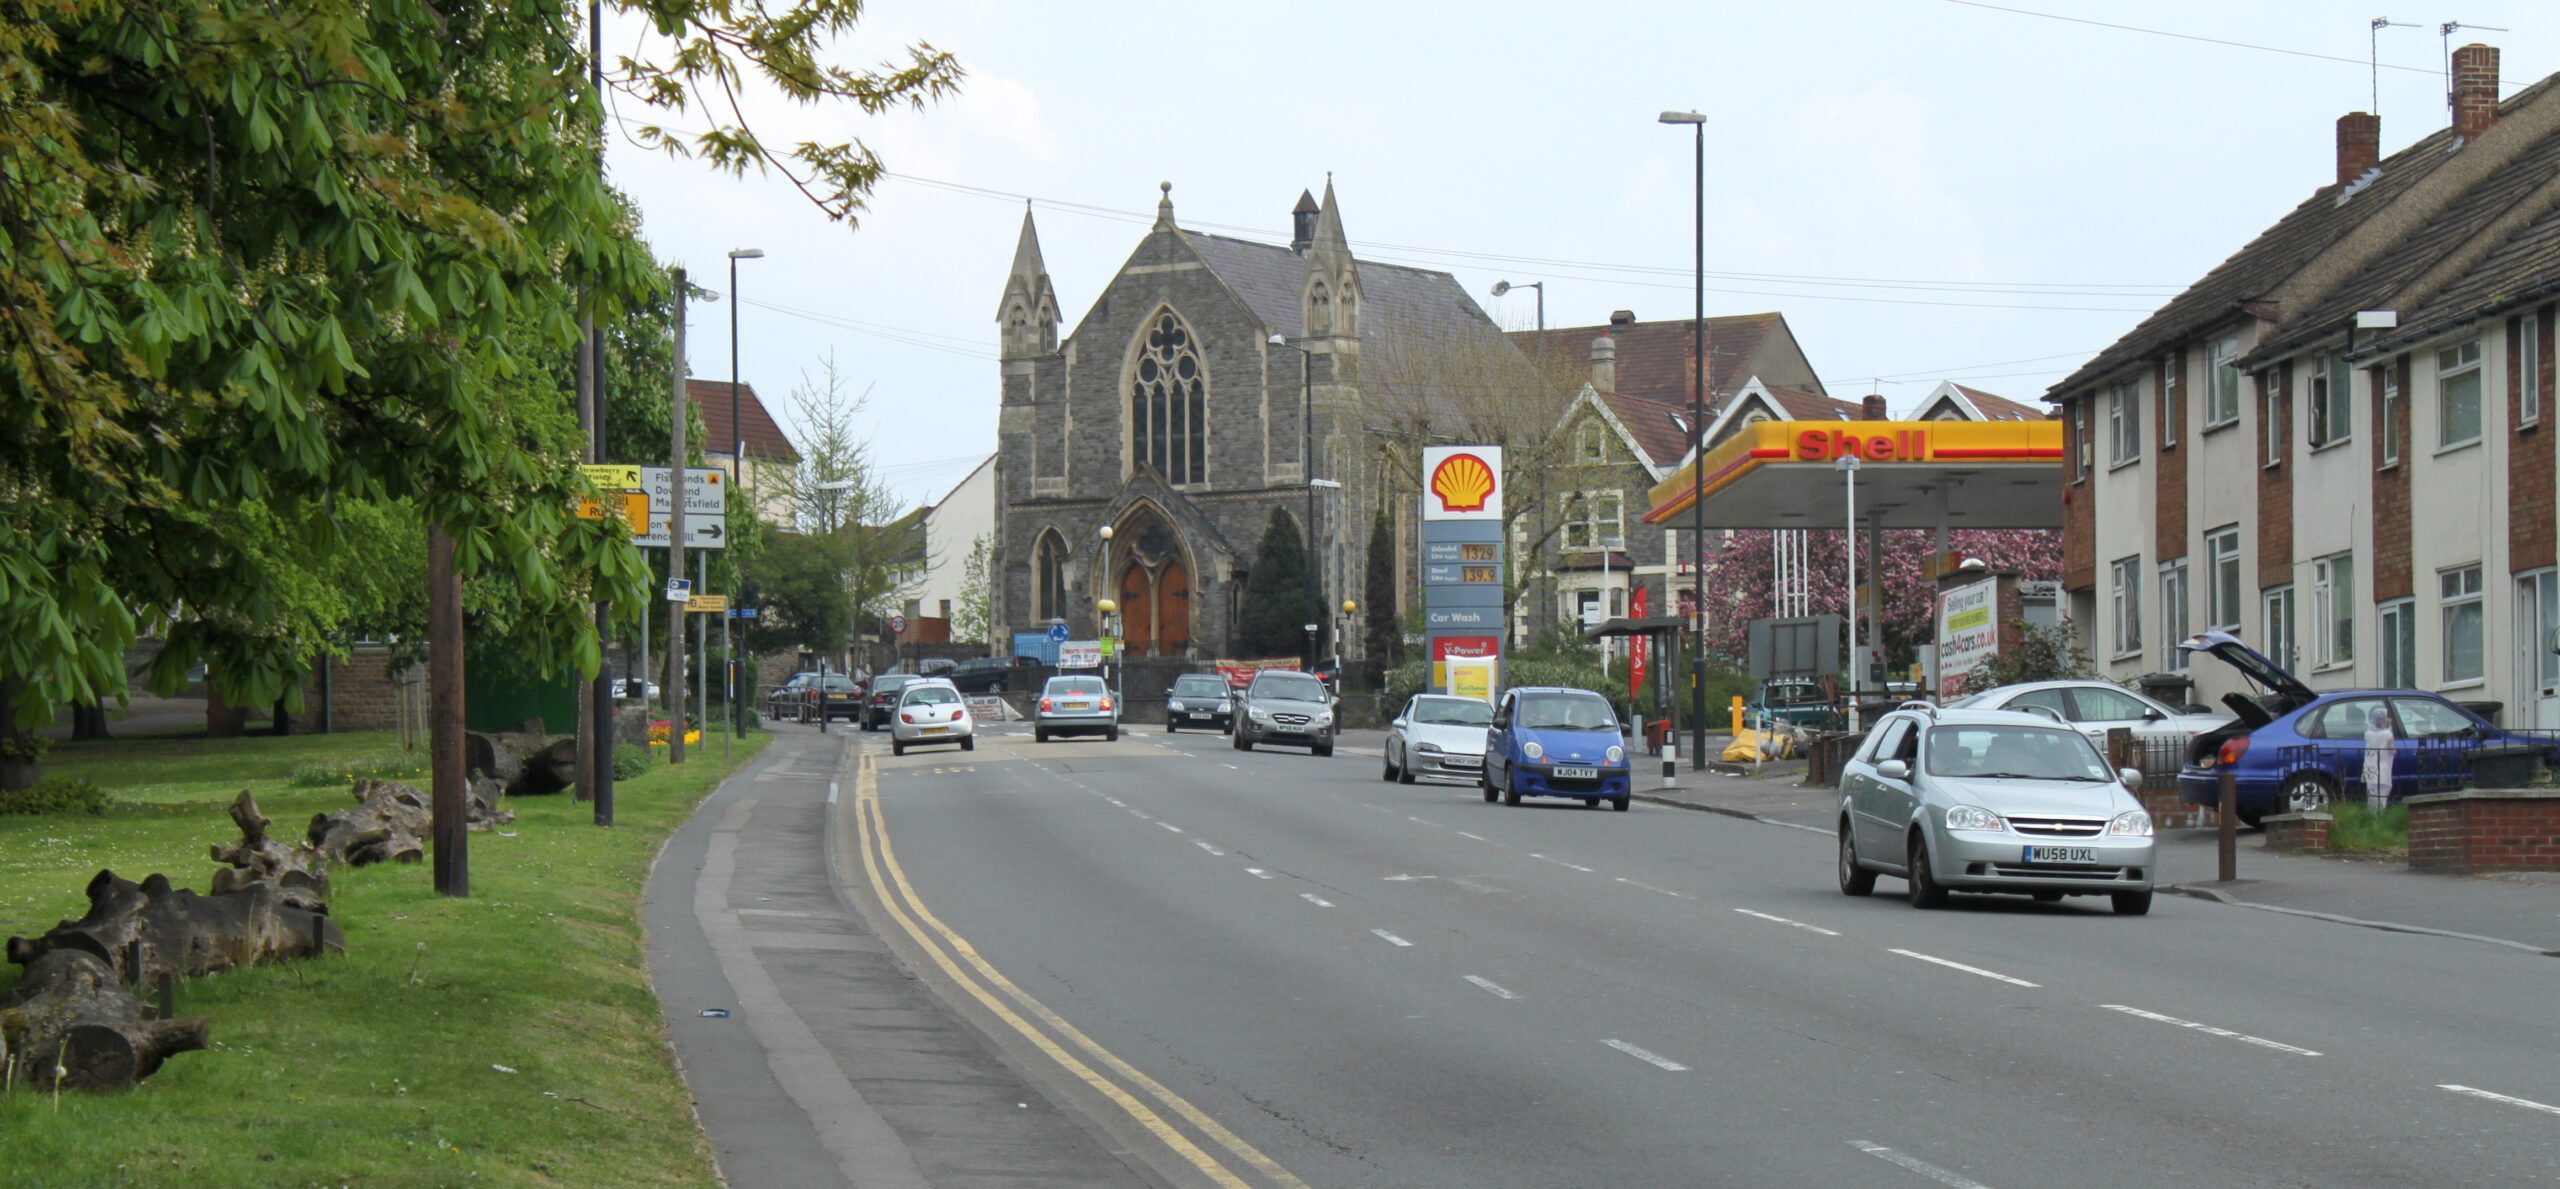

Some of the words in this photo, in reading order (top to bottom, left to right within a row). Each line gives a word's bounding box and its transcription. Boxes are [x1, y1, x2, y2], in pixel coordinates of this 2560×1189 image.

[1797, 429, 1925, 460] Shell
[1947, 595, 1964, 613] Selling
[1964, 593, 1976, 611] your
[1430, 613, 1449, 622] Car
[1451, 612, 1480, 622] Wash
[893, 620, 904, 628] 20
[1940, 624, 1997, 659] cash4cars.co.uk
[1444, 646, 1485, 655] V-Power
[1557, 766, 1577, 776] WJ04
[1579, 767, 1595, 777] TVY
[2033, 847, 2067, 860] WU58
[2070, 848, 2096, 861] UXL
